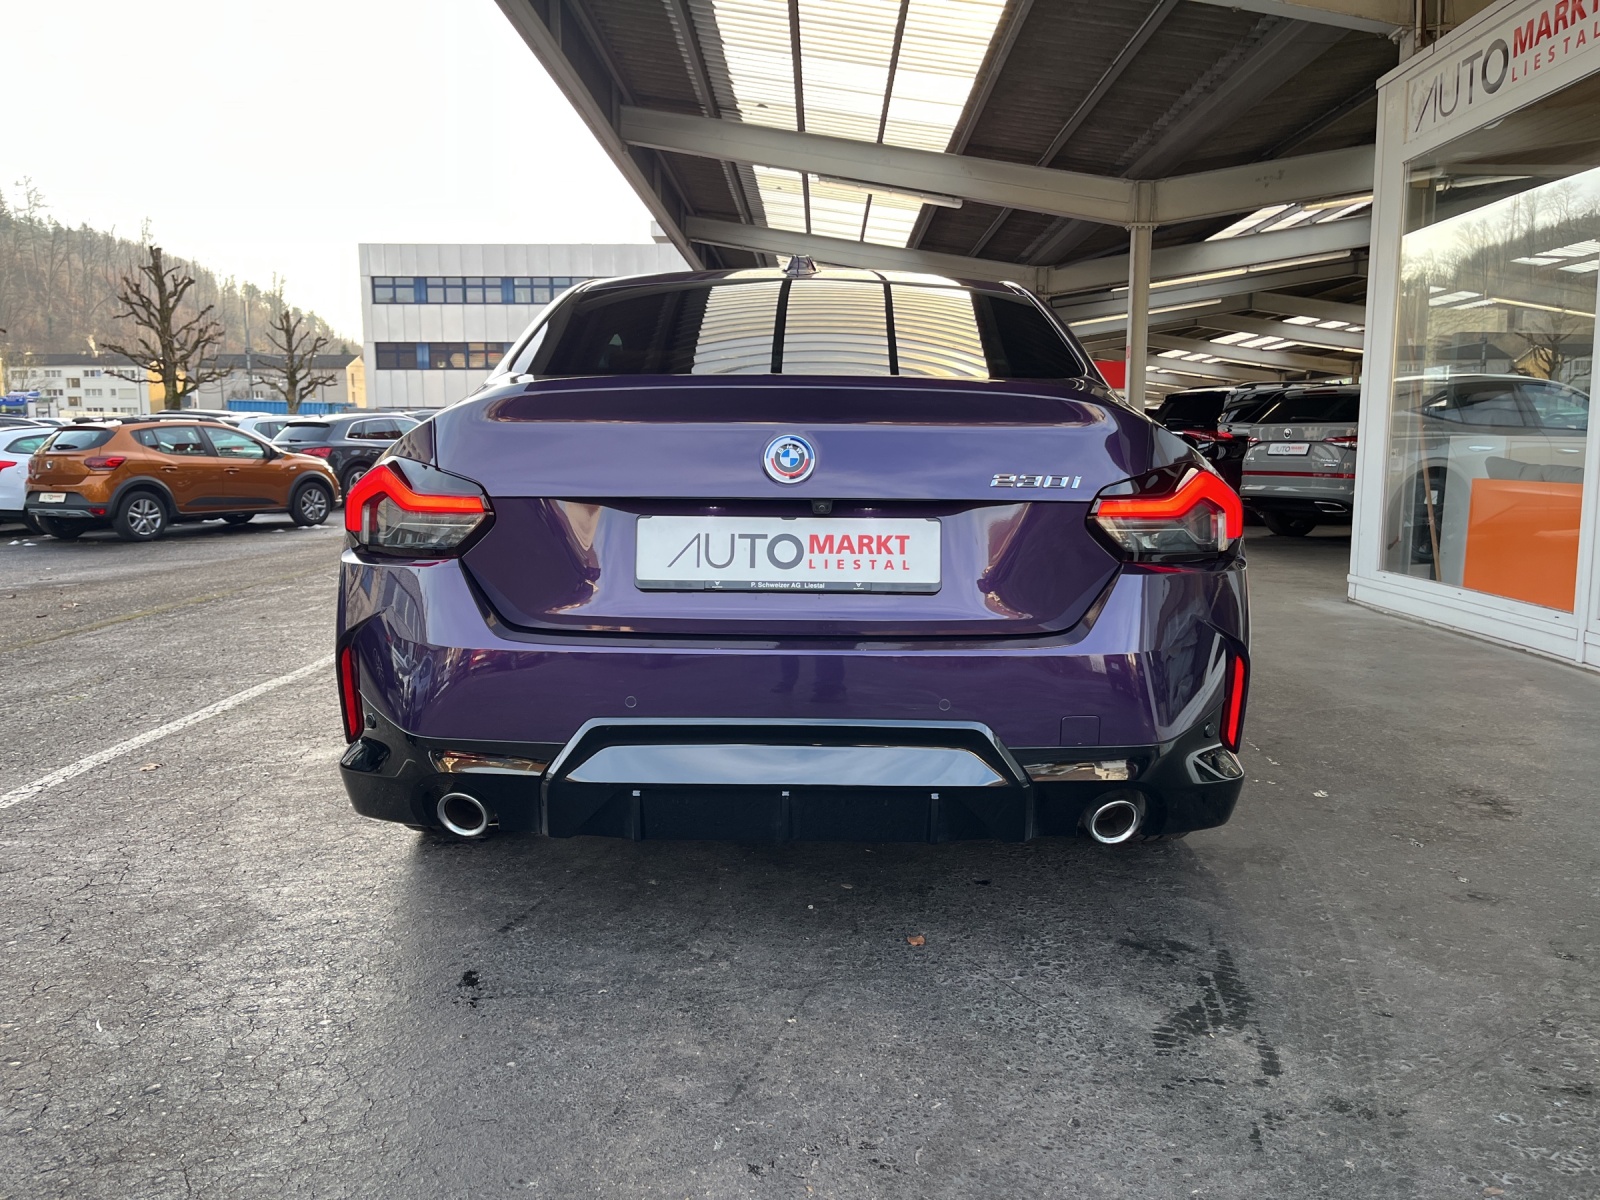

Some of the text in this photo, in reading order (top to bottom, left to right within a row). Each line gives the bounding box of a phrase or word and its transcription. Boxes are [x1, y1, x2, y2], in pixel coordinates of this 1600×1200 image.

[1511, 21, 1600, 82] LIESTAL
[1415, 38, 1509, 132] AUTO
[990, 474, 1082, 489] 230i
[667, 533, 911, 570] AUTO MARKT
[808, 559, 911, 571] LIESTAL
